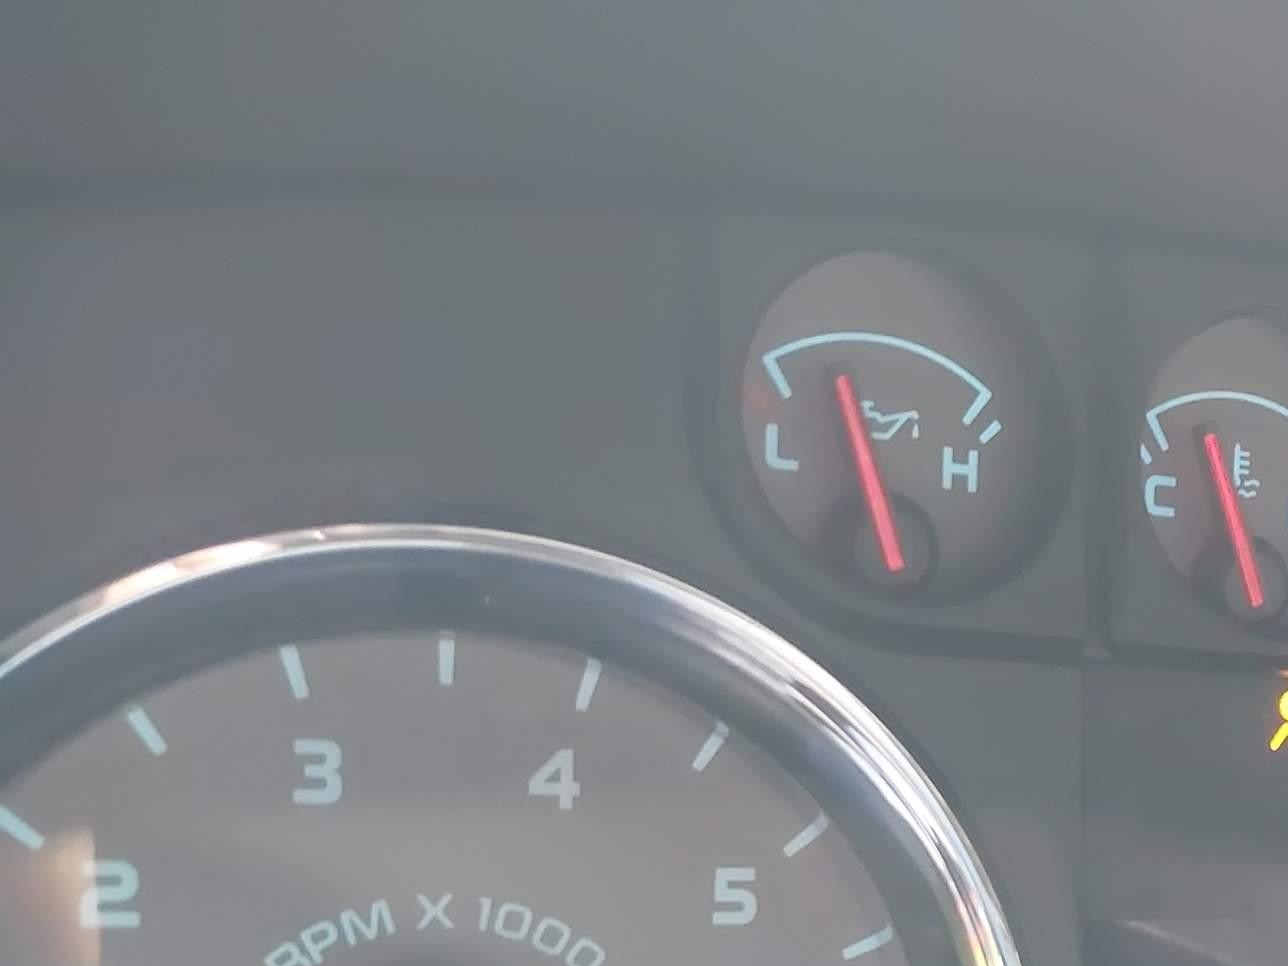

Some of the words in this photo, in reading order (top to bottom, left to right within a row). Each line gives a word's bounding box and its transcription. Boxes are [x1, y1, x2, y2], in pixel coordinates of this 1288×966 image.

[765, 423, 799, 471] L
[942, 446, 979, 492] H
[1144, 476, 1176, 518] C
[292, 739, 343, 805] 3
[528, 748, 581, 810] 4
[79, 859, 141, 929] 2
[416, 893, 455, 930] X
[711, 866, 758, 926] 5
